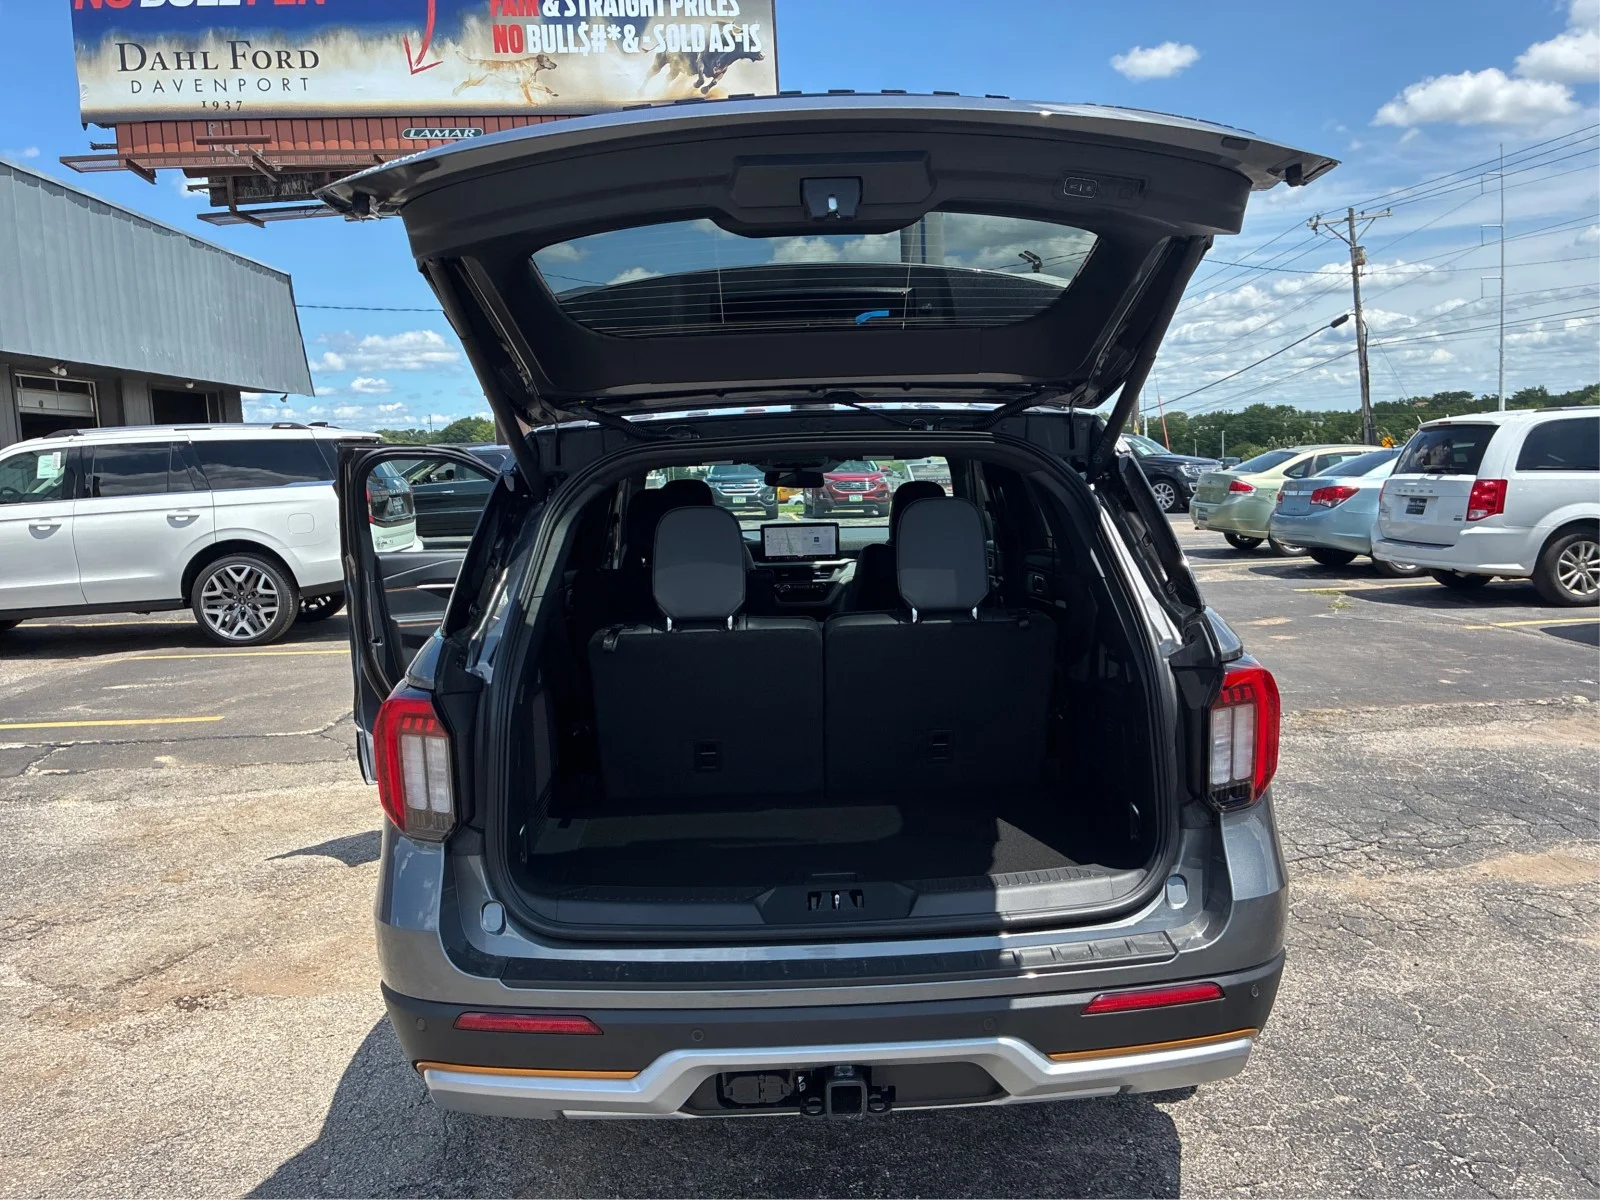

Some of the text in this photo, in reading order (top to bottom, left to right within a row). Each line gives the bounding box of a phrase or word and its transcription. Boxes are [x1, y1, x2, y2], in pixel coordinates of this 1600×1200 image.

[492, 24, 524, 54] NO
[652, 23, 706, 53] SOLD
[708, 23, 761, 53] AS-IS
[130, 77, 309, 94] DAVENPORT
[201, 100, 243, 112] 1937
[409, 129, 476, 138] LAMAR
